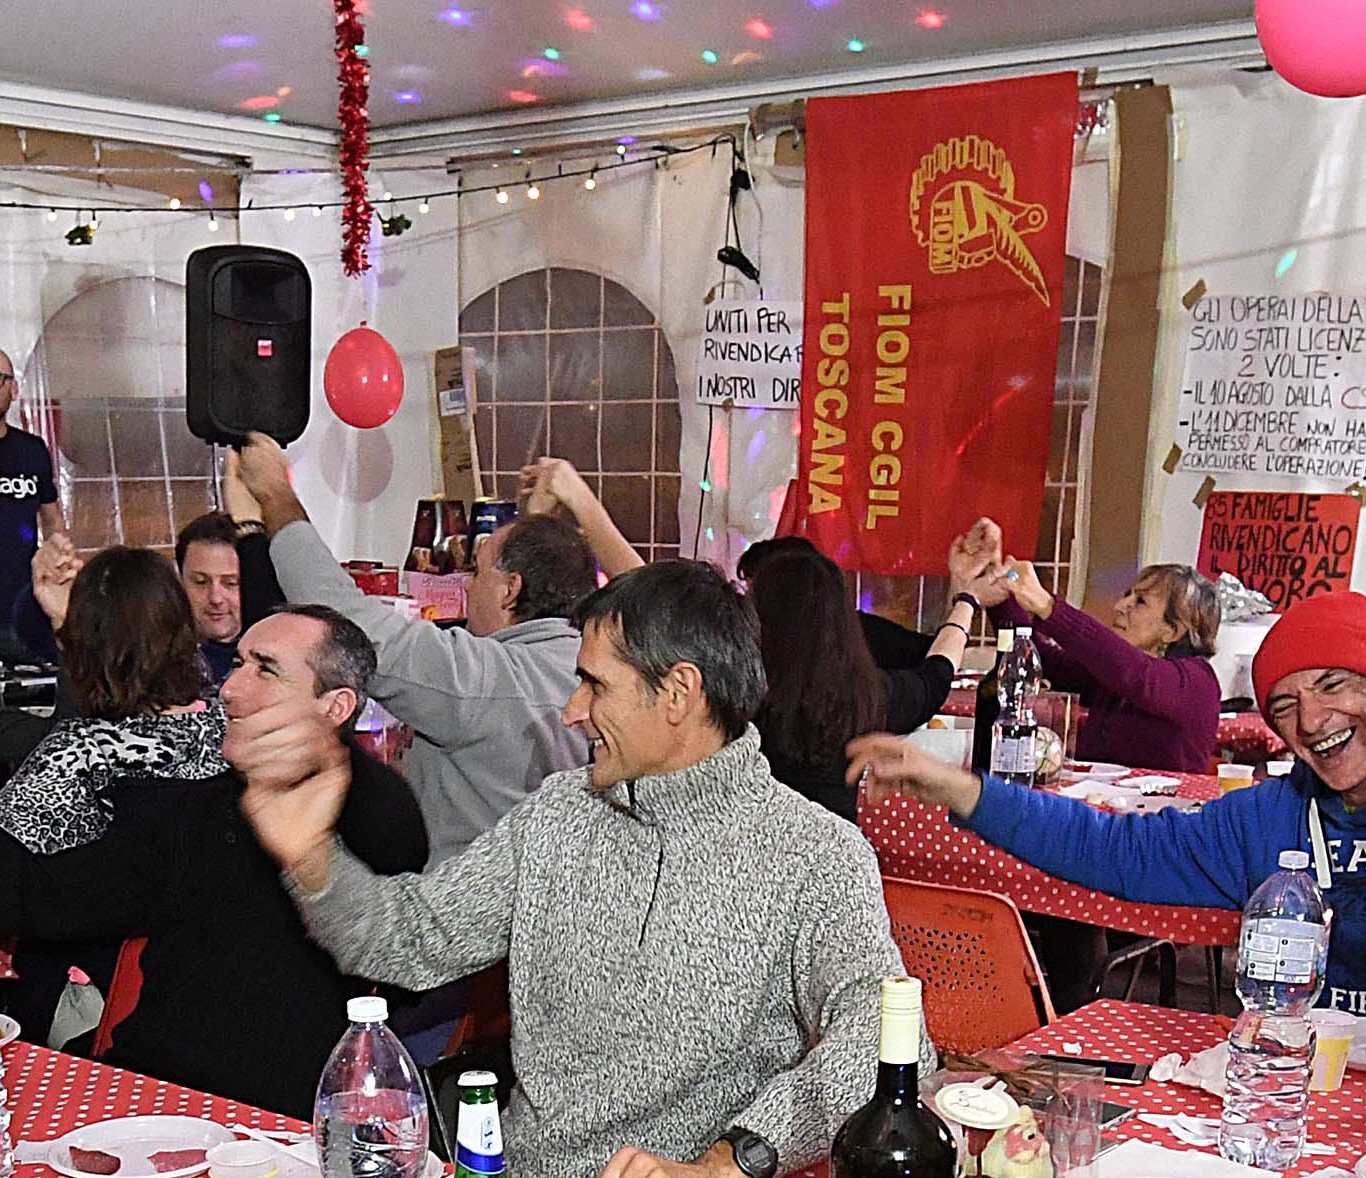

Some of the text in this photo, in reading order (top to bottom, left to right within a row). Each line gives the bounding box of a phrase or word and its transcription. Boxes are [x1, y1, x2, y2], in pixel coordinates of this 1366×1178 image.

[705, 306, 791, 335] UNITI PER
[1193, 297, 1220, 323] GLI
[1231, 296, 1296, 322] OPERAI
[1303, 296, 1363, 324] DELLA
[1190, 325, 1238, 352] SONO
[1243, 326, 1290, 352] STATI
[1237, 353, 1255, 378] 2
[706, 372, 756, 399] NOSTRI
[1210, 380, 1226, 405] 10
[1227, 380, 1275, 406] AGOSTO
[1285, 384, 1332, 408] DALLA
[809, 292, 851, 515] TOSCANA
[866, 283, 912, 530] FIOM CGIL
[1223, 410, 1299, 434] DICEMBRE
[1307, 418, 1336, 437] NON
[1188, 432, 1250, 451] PERMESSO
[1254, 435, 1275, 452] AL
[1182, 452, 1257, 471] CONCLUDERE
[1230, 494, 1322, 523] FAMIGLIE
[1209, 522, 1353, 555] RIVENDICANO
[1209, 552, 1348, 580] IL DIRITTO AL
